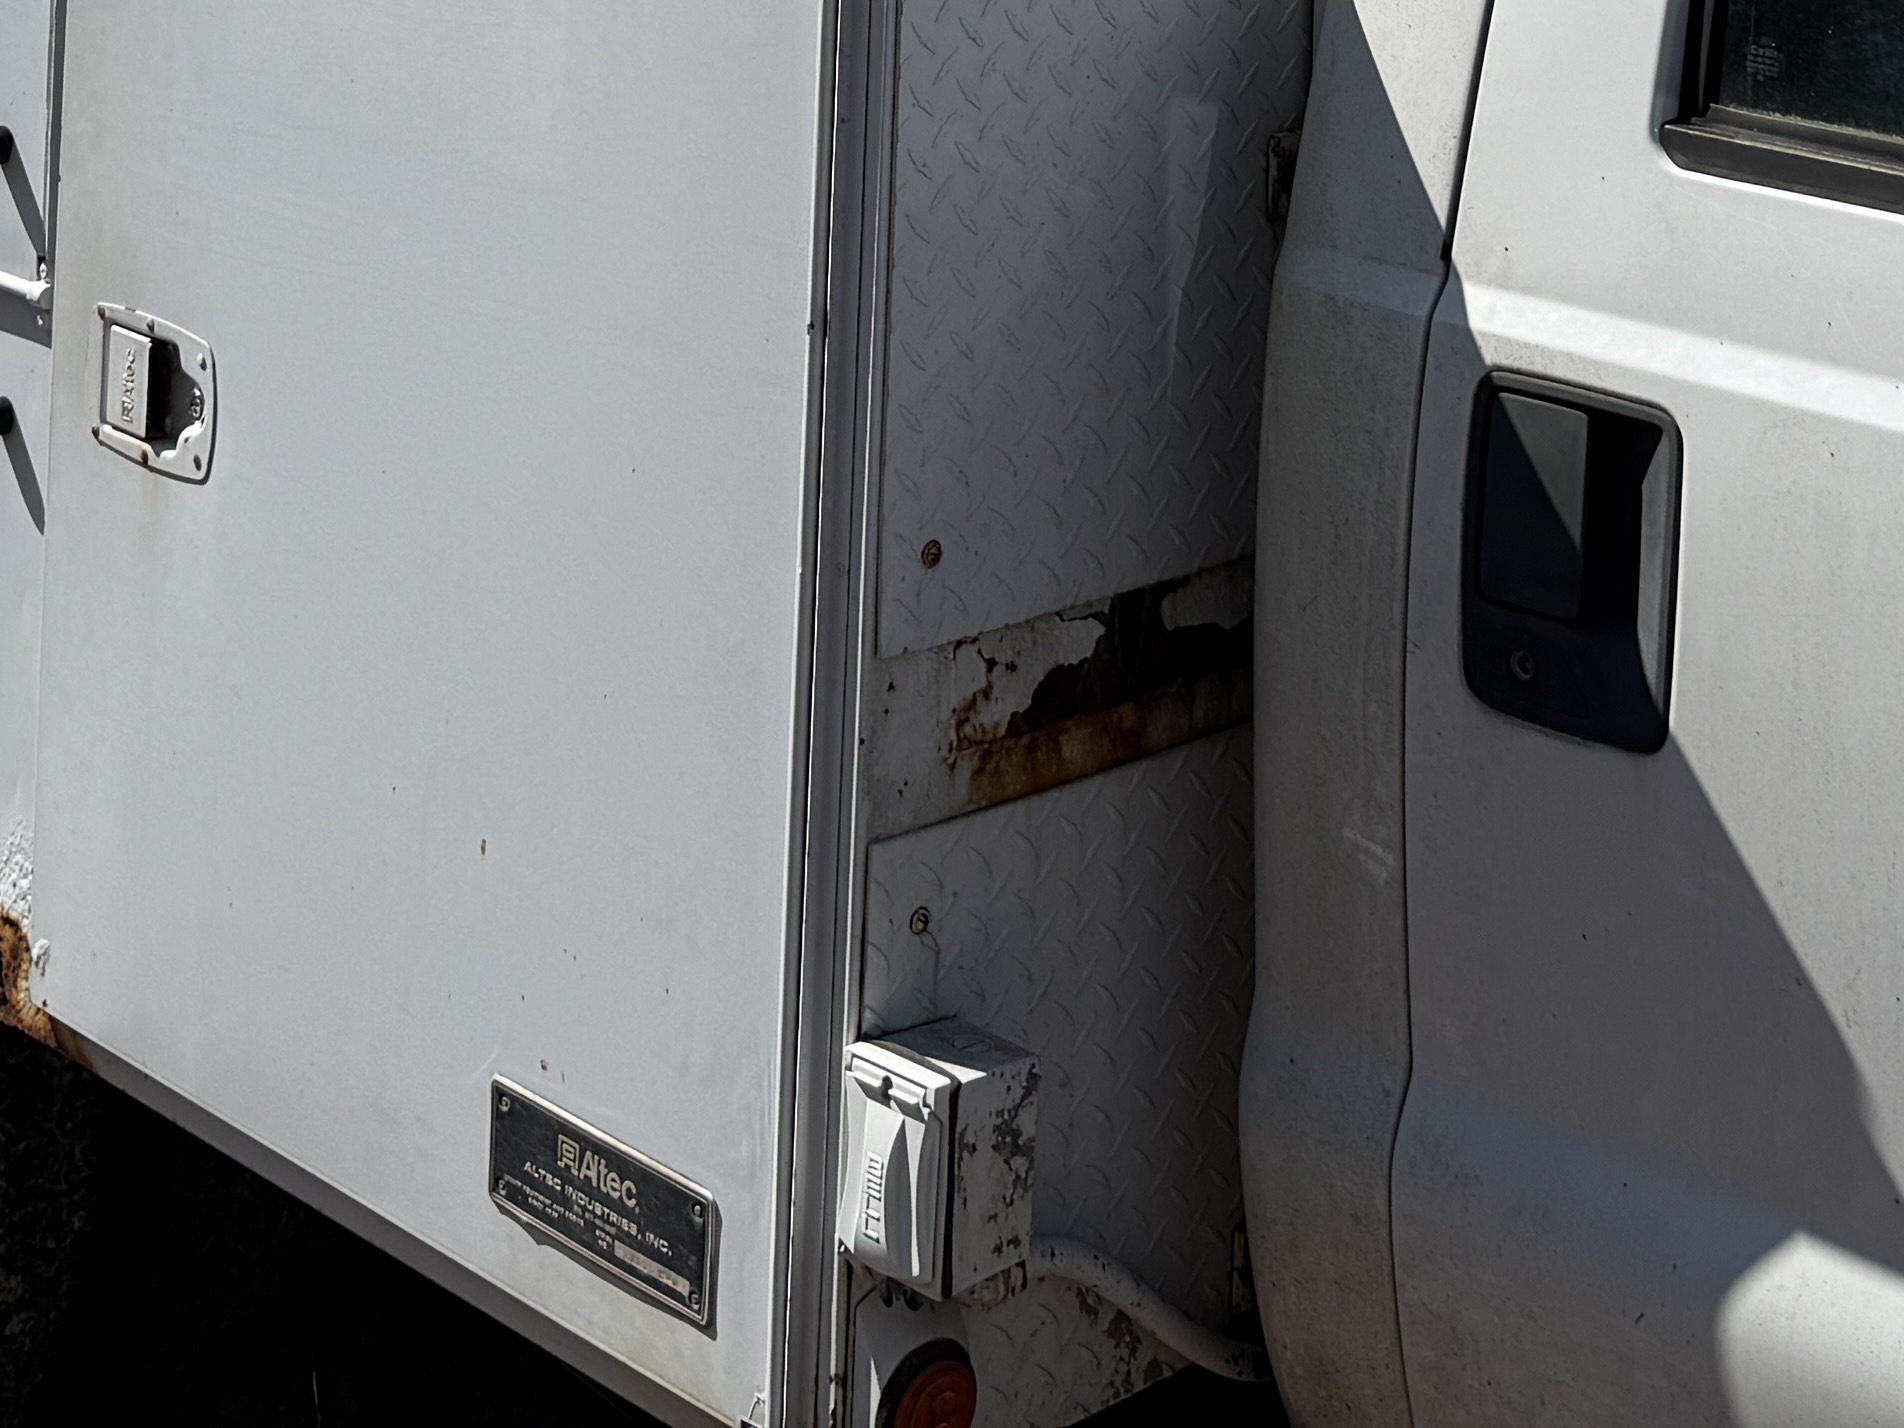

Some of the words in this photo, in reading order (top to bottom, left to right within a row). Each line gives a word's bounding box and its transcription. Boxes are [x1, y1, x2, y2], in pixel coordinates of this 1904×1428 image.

[523, 1161, 562, 1191] ALTEC
[646, 1227, 673, 1256] INC.
[578, 1151, 637, 1207] Altec
